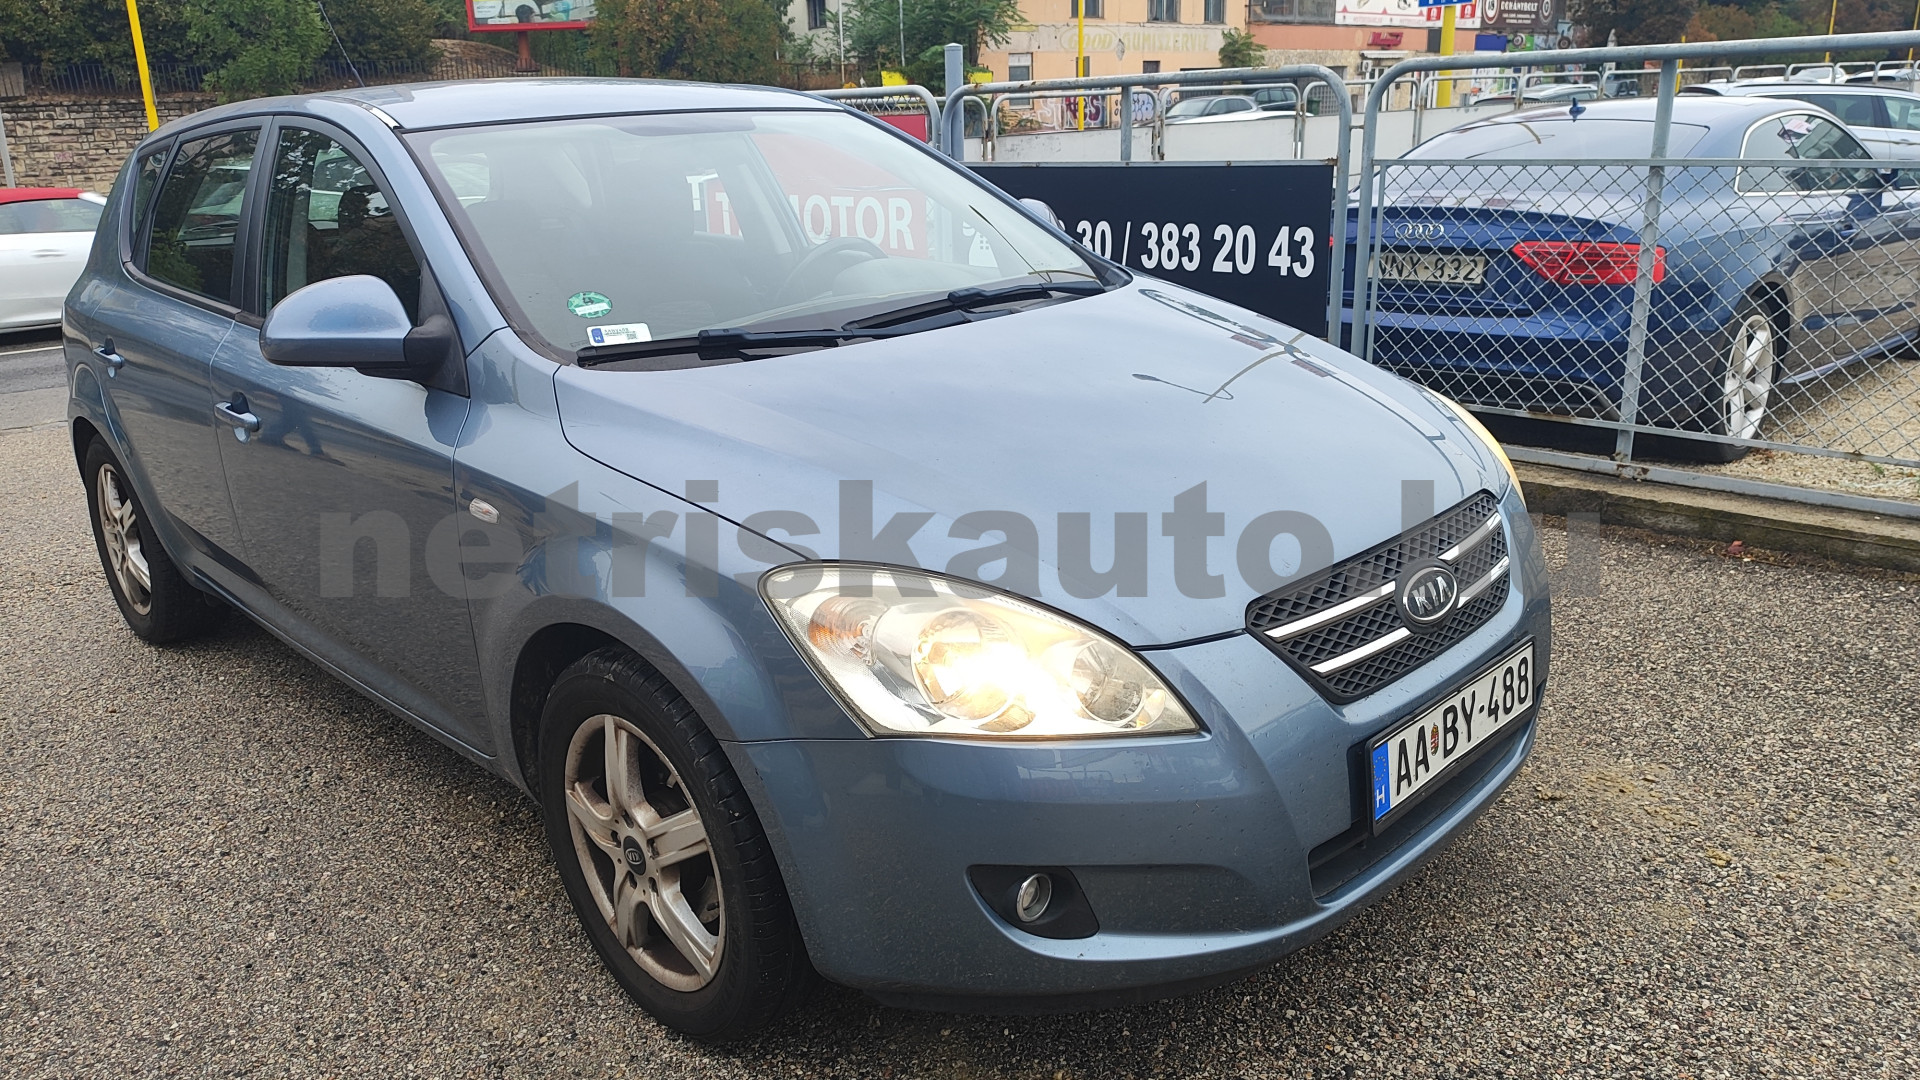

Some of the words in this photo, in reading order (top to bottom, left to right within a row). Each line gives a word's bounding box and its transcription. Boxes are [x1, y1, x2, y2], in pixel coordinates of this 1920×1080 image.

[1140, 221, 1201, 272] 383
[1212, 223, 1256, 275] 20
[1267, 225, 1315, 278] 43
[1411, 575, 1453, 615] KIA
